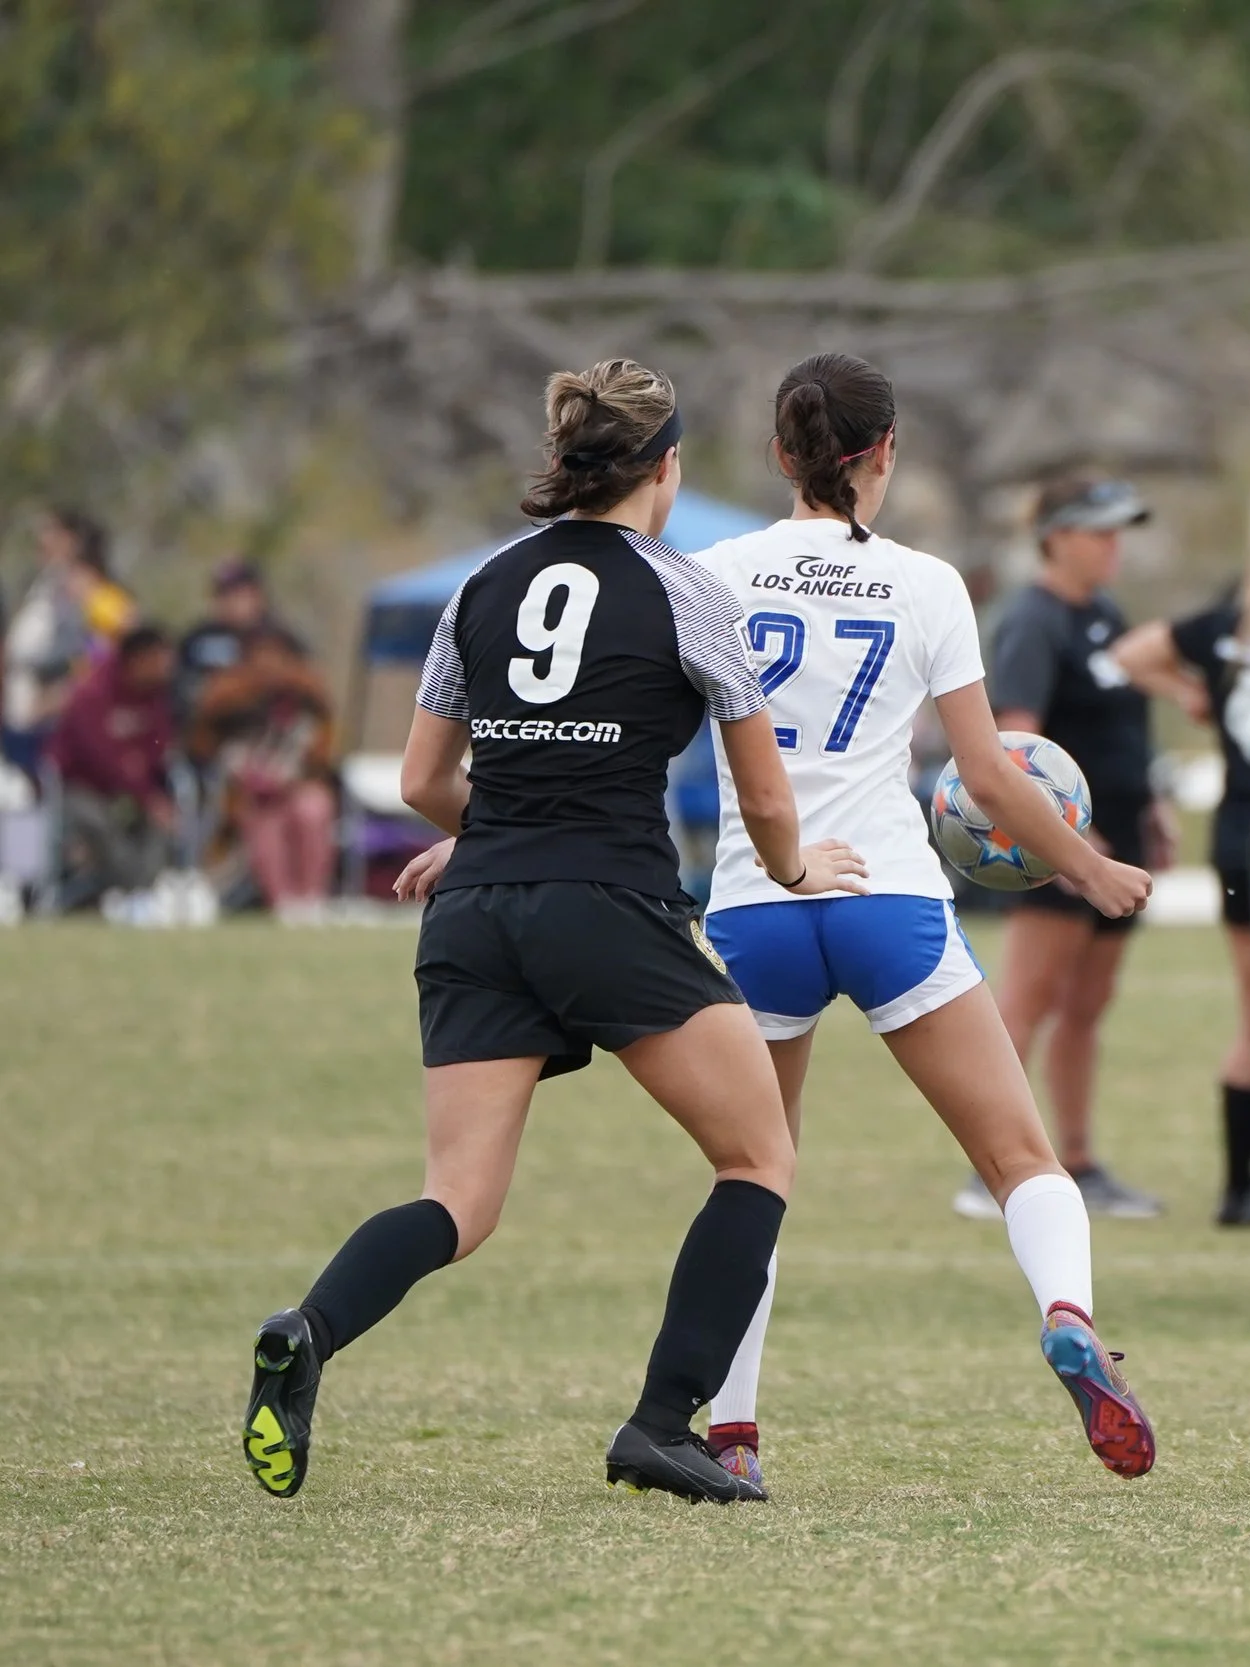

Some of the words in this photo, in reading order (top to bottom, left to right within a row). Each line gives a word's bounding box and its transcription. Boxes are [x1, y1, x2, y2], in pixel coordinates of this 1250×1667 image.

[797, 558, 857, 579] SURF
[751, 573, 794, 592] LOS
[794, 580, 893, 600] ANGELES
[507, 562, 600, 704] 9
[746, 611, 896, 754] 27
[470, 718, 622, 743] SOCCER.COM
